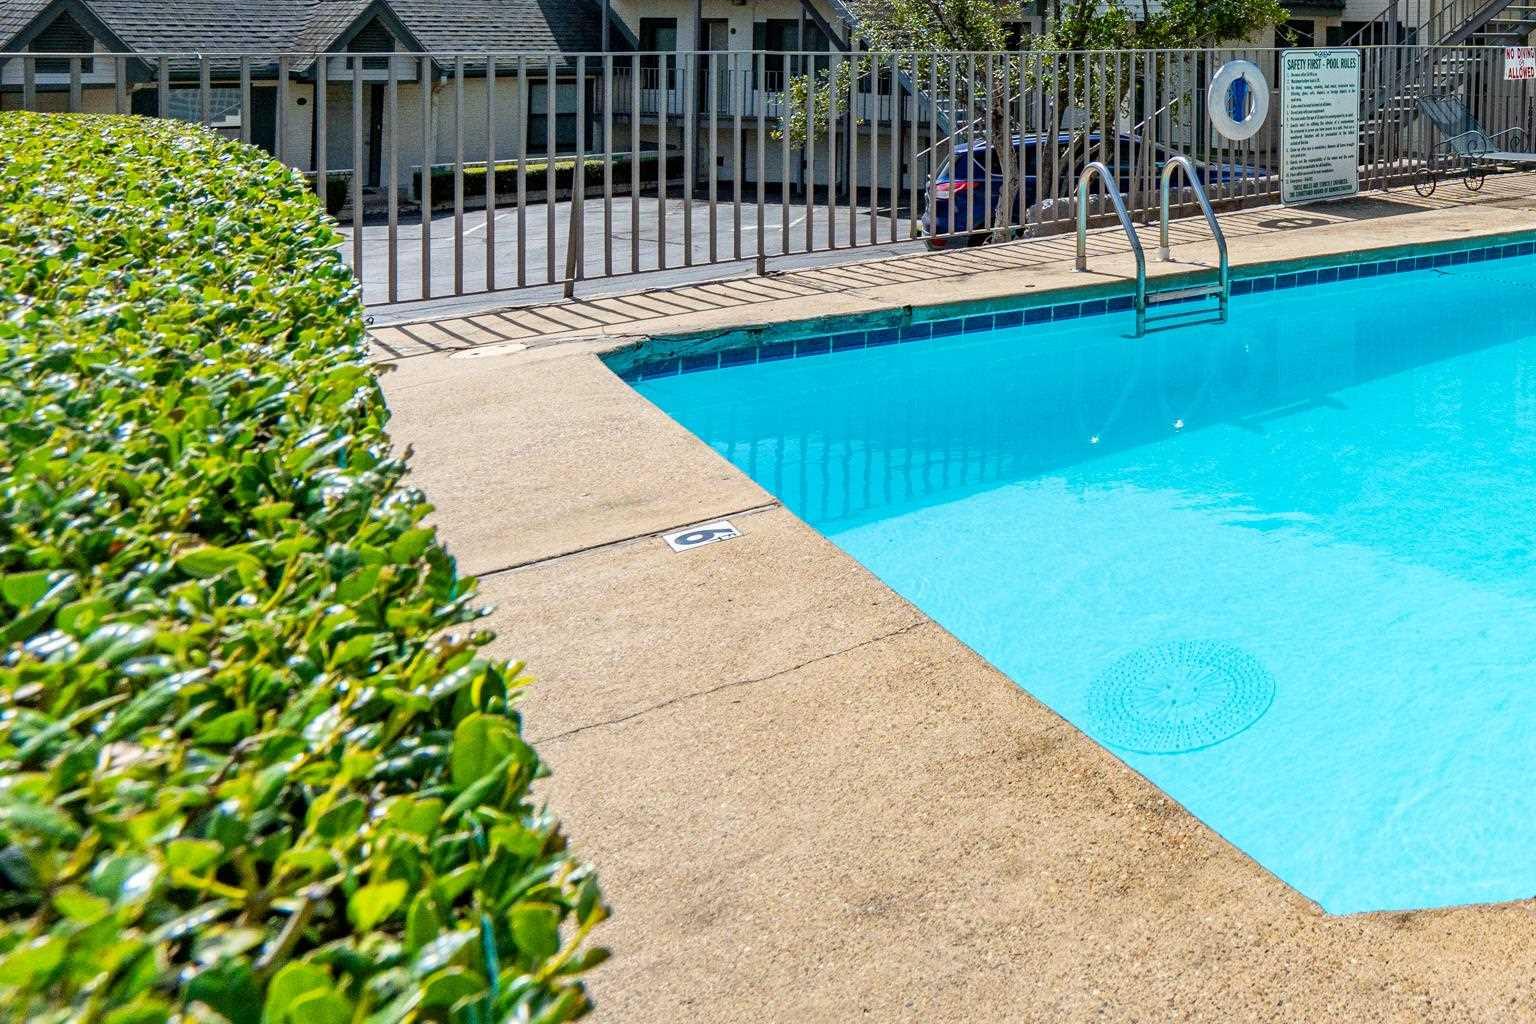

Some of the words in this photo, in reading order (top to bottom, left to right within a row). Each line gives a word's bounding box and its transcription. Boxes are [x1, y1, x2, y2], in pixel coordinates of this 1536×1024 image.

[1506, 48, 1515, 59] NO
[1517, 47, 1535, 59] DIVING
[1287, 58, 1306, 70] SAFETY
[1307, 58, 1321, 69] FIRST
[1326, 58, 1339, 69] POOL
[1340, 57, 1356, 68] RULES
[1508, 66, 1535, 79] ALLOWED
